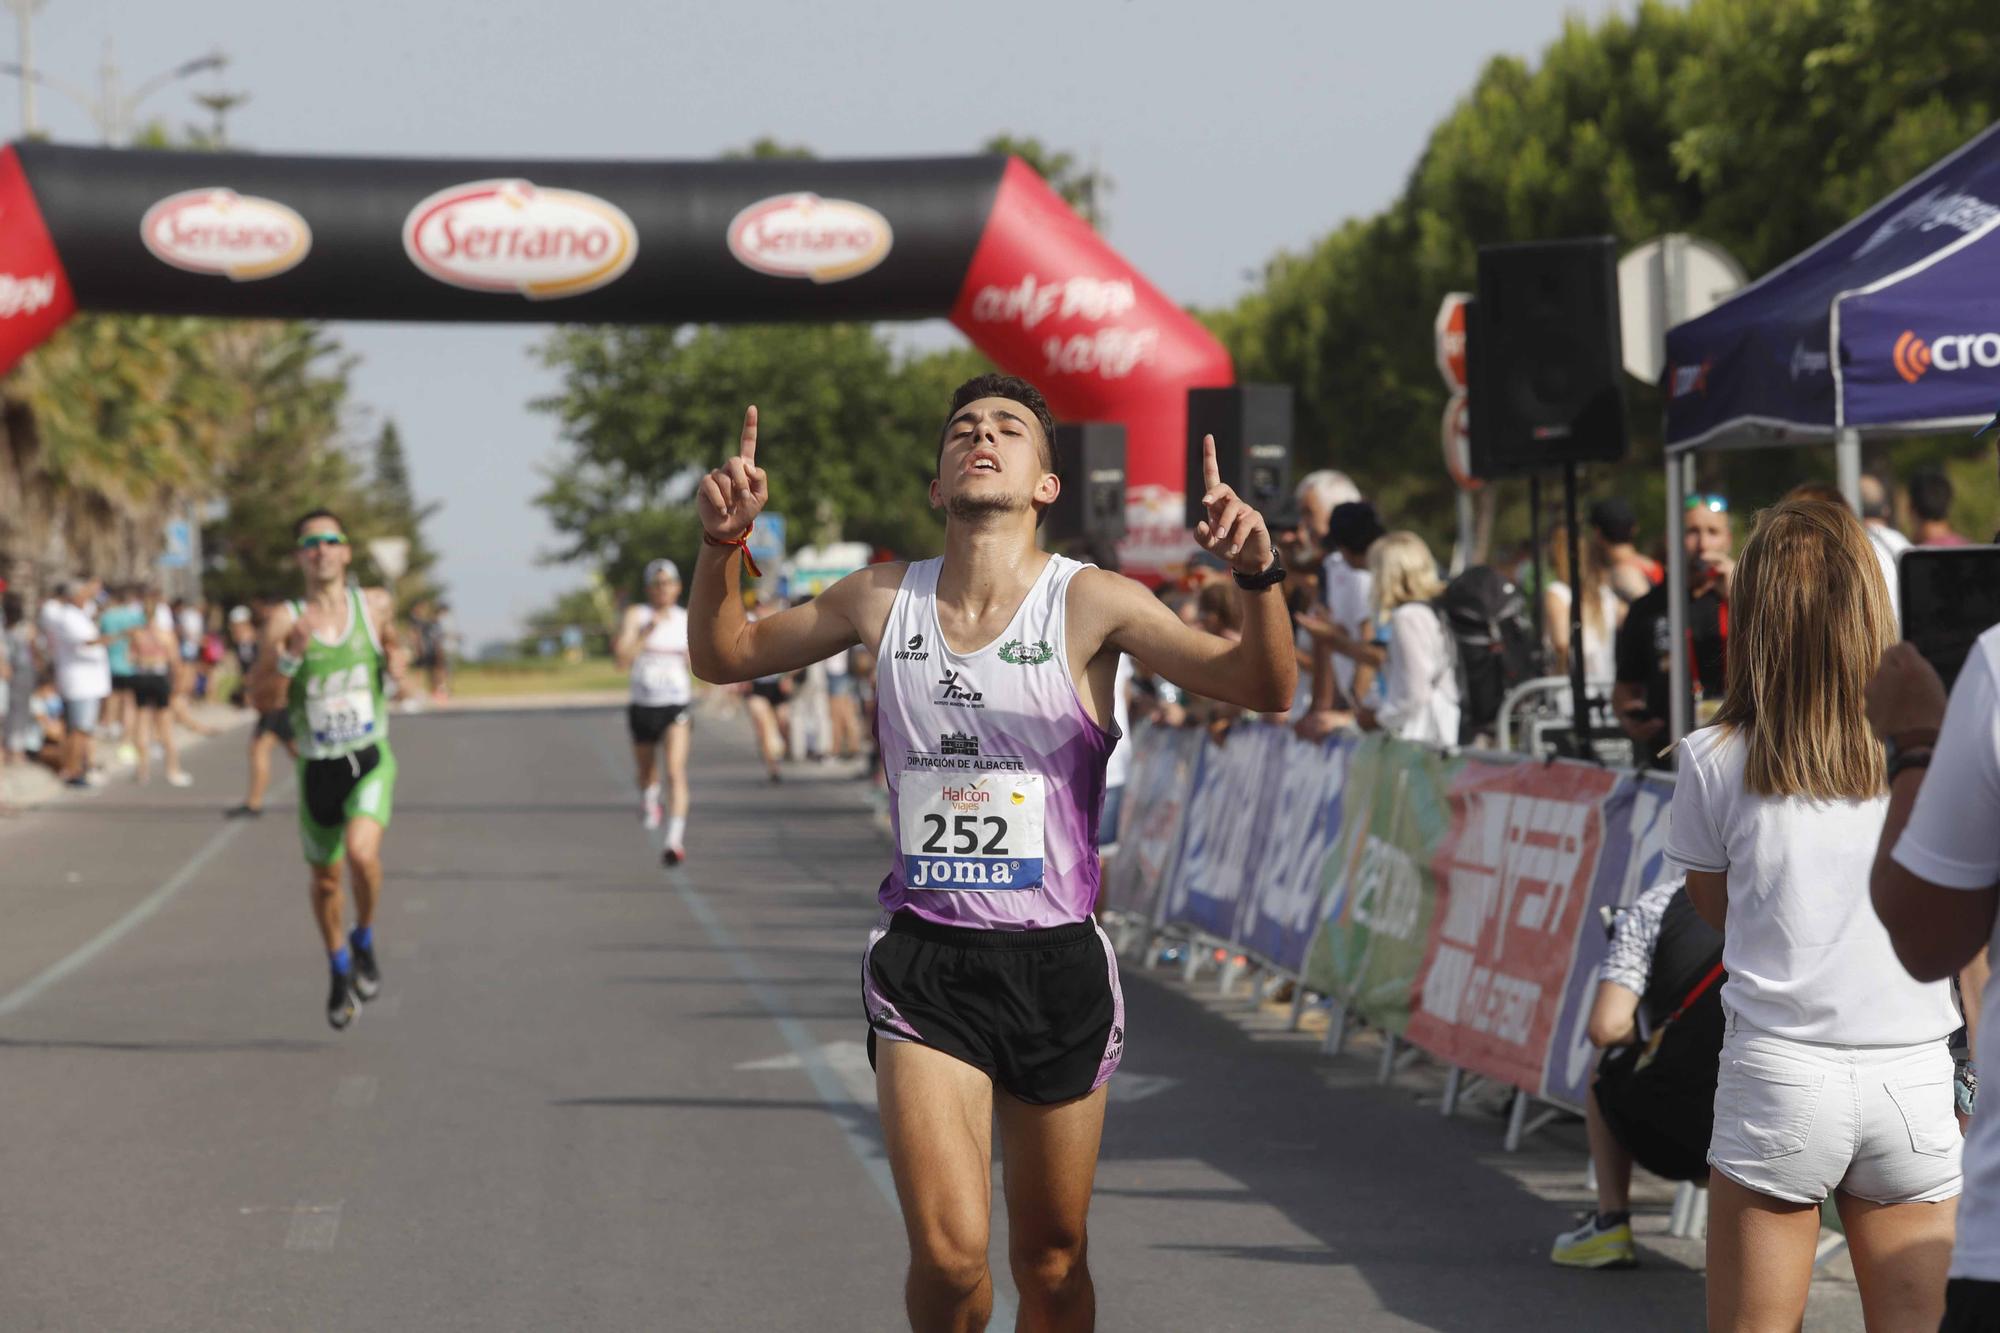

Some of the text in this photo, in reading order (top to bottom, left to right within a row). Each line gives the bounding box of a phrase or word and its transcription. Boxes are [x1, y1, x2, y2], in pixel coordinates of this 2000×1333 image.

[166, 216, 291, 251] Serrano
[437, 216, 610, 262] Serrano
[755, 221, 873, 254] Serrano
[894, 650, 929, 661] VIATOR
[907, 756, 1024, 771] DIPUTACIÓN DE ALBACETE
[922, 813, 1009, 855] 252
